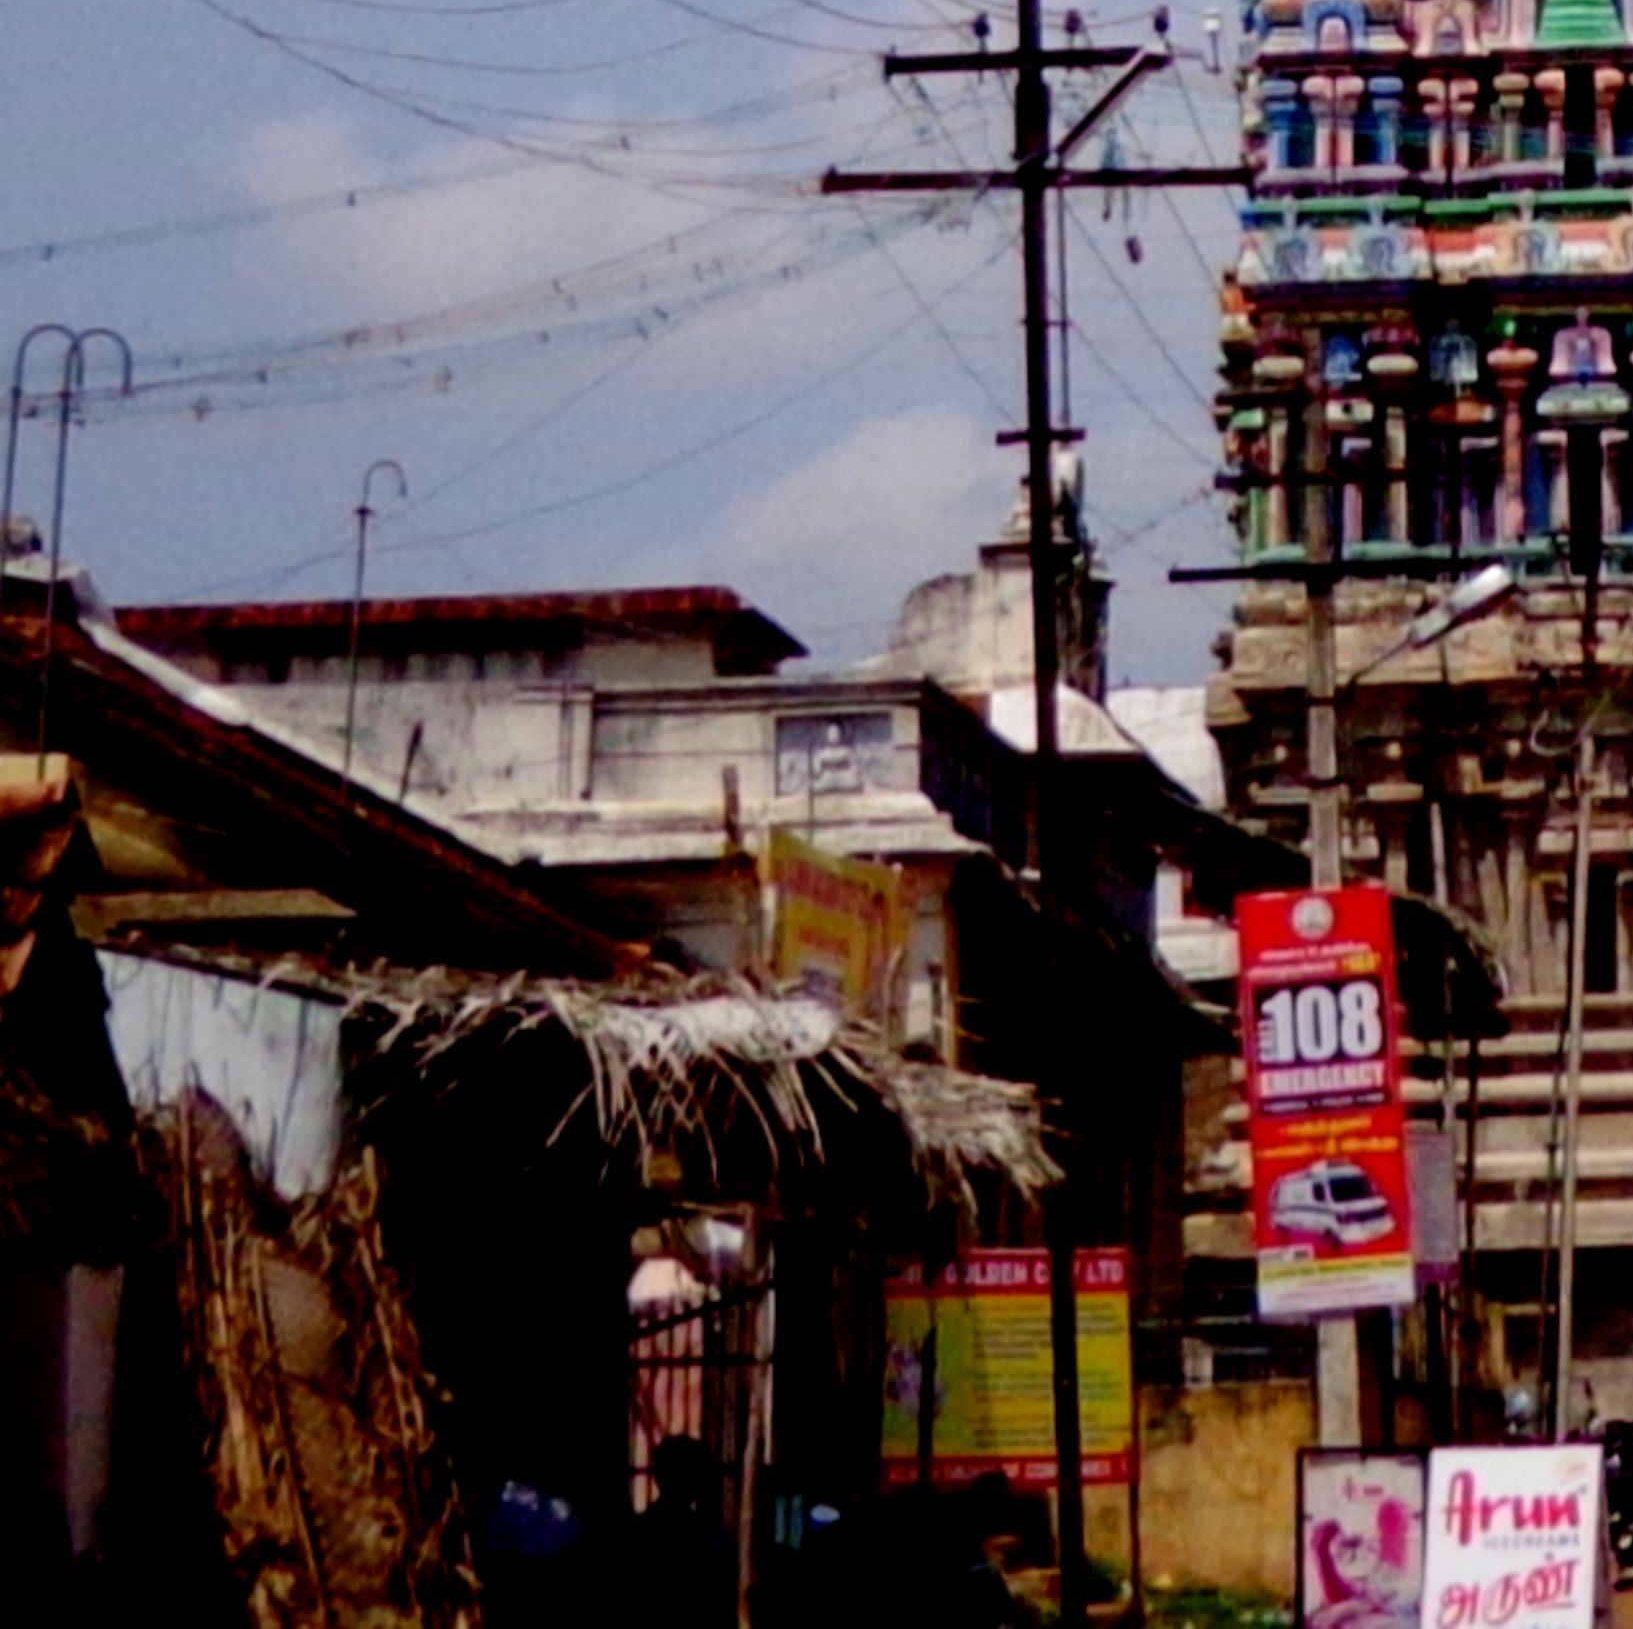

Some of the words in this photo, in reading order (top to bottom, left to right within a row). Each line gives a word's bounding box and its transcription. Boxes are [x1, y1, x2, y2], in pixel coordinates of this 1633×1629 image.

[1260, 979, 1382, 1064] 108
[1259, 1060, 1385, 1099] EMERGENCY
[1440, 1469, 1580, 1547] Arun
[1436, 1553, 1580, 1629] அருண்
